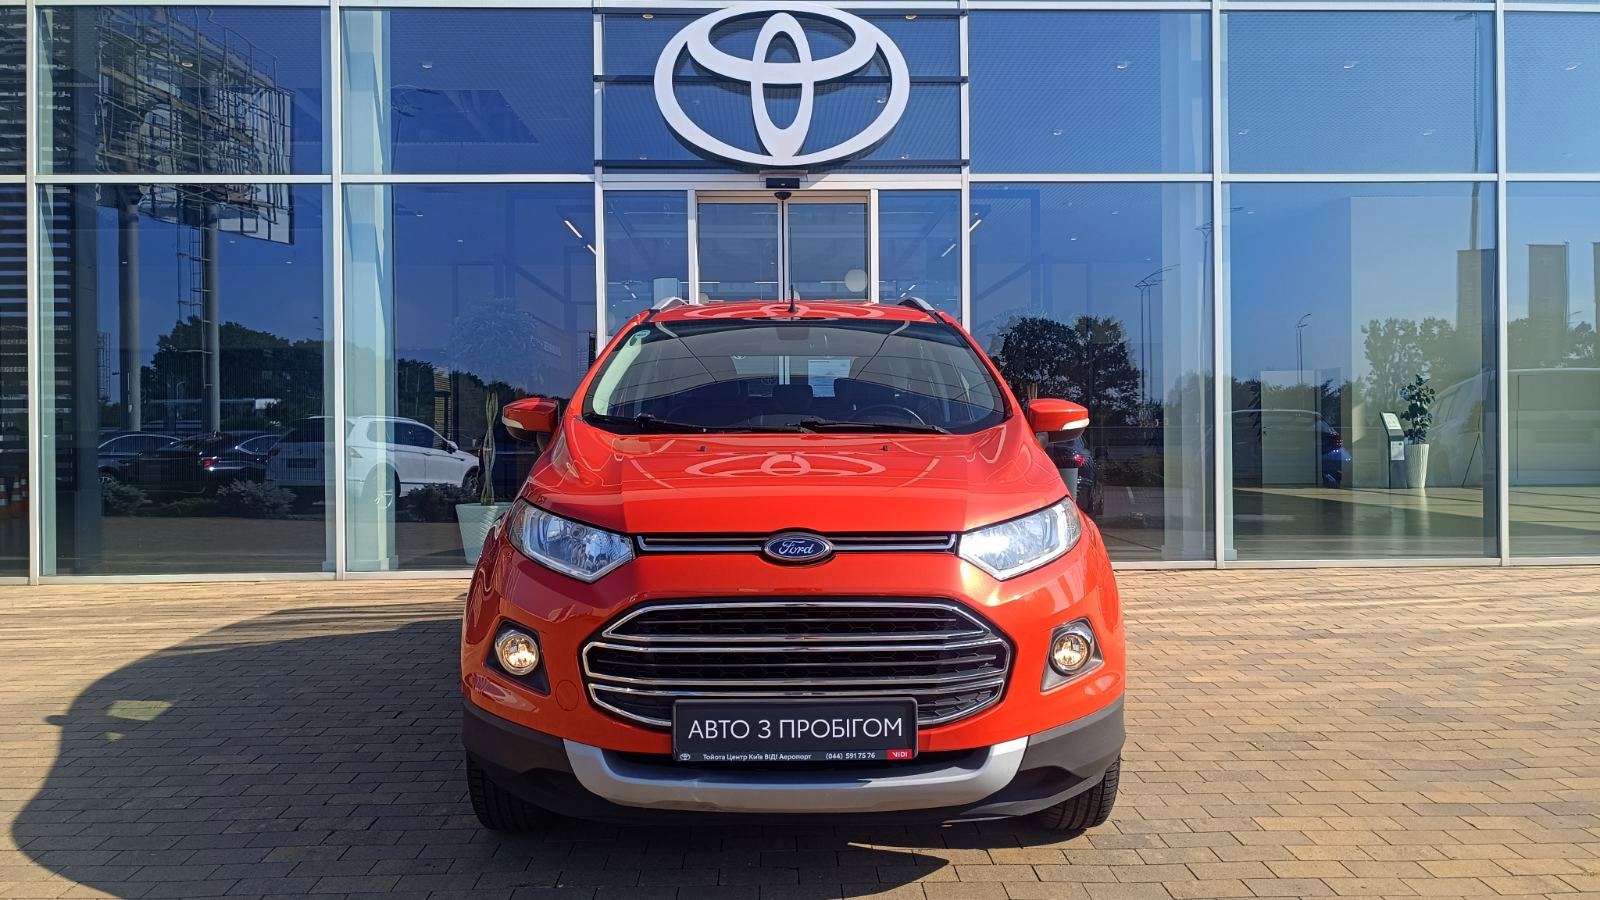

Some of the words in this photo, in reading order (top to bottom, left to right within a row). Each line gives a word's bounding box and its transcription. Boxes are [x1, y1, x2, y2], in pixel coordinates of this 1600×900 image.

[778, 540, 814, 555] Ford
[688, 719, 750, 739] АВТО
[757, 719, 771, 739] З
[779, 717, 902, 739] ПРОБІГОМ
[702, 753, 726, 761] Тойота
[726, 753, 747, 762] Центр
[779, 753, 812, 762] Аеропорт
[825, 752, 843, 760] (044)
